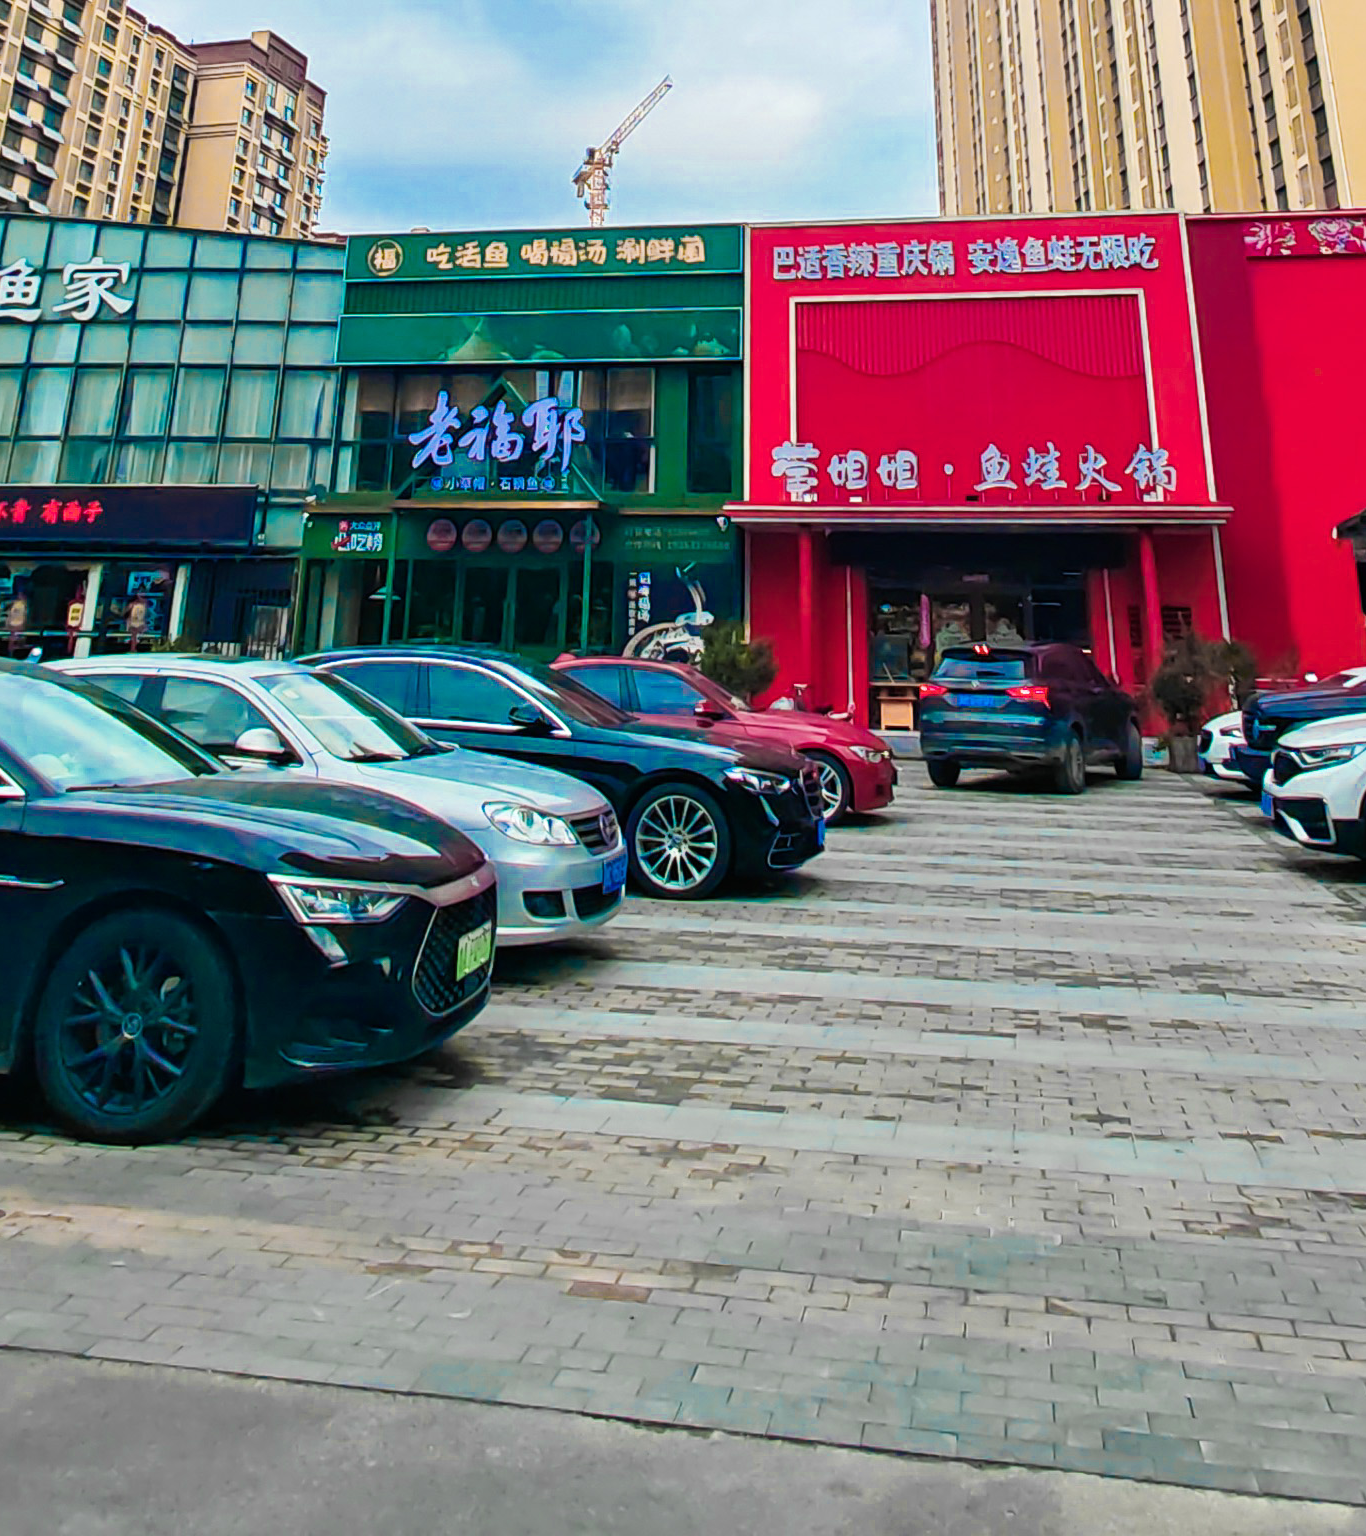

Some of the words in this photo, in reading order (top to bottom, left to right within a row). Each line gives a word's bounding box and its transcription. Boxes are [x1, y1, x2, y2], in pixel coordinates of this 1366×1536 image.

[426, 241, 509, 270] 吃活鱼
[772, 240, 955, 280] 巴适香辣重庆锅
[967, 233, 1159, 275] 安逸鱼蛙无限吃
